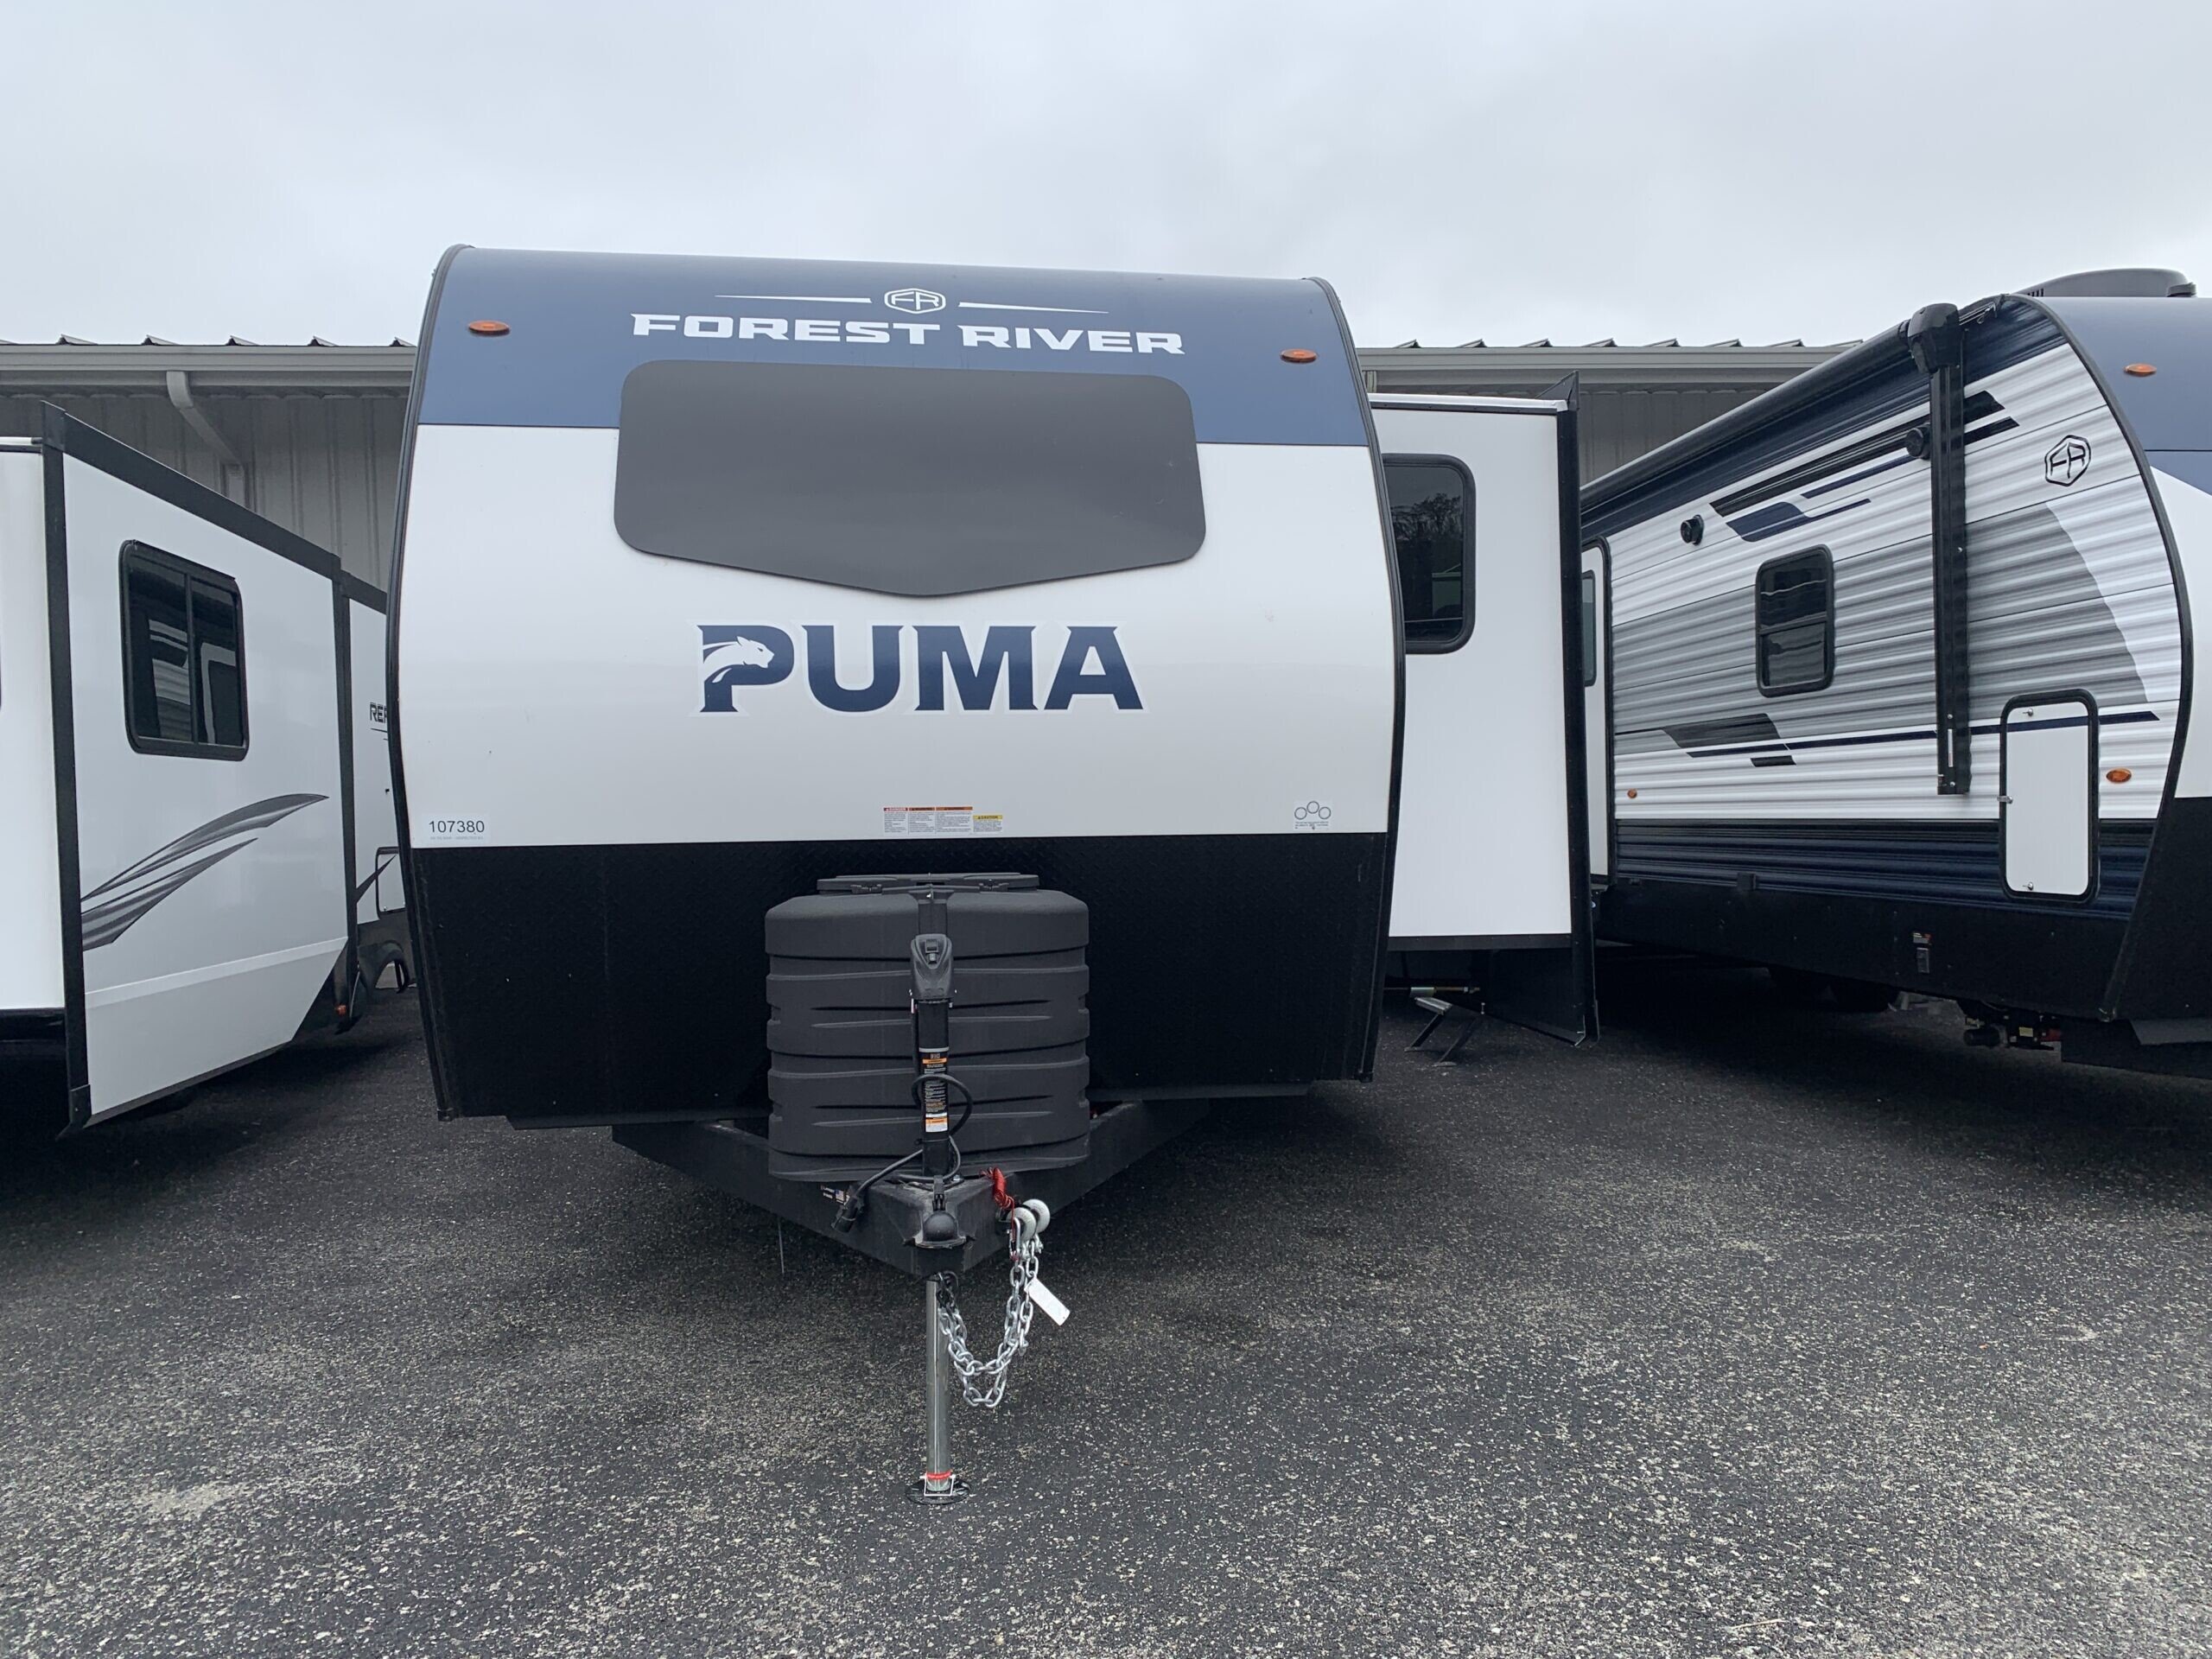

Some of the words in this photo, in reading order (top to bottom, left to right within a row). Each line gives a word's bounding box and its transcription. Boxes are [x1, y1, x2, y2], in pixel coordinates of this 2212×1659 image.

[630, 313, 941, 346] FOREST
[957, 324, 1186, 355] RIVER
[695, 624, 1145, 713] PUMA
[429, 820, 485, 833] 107380
